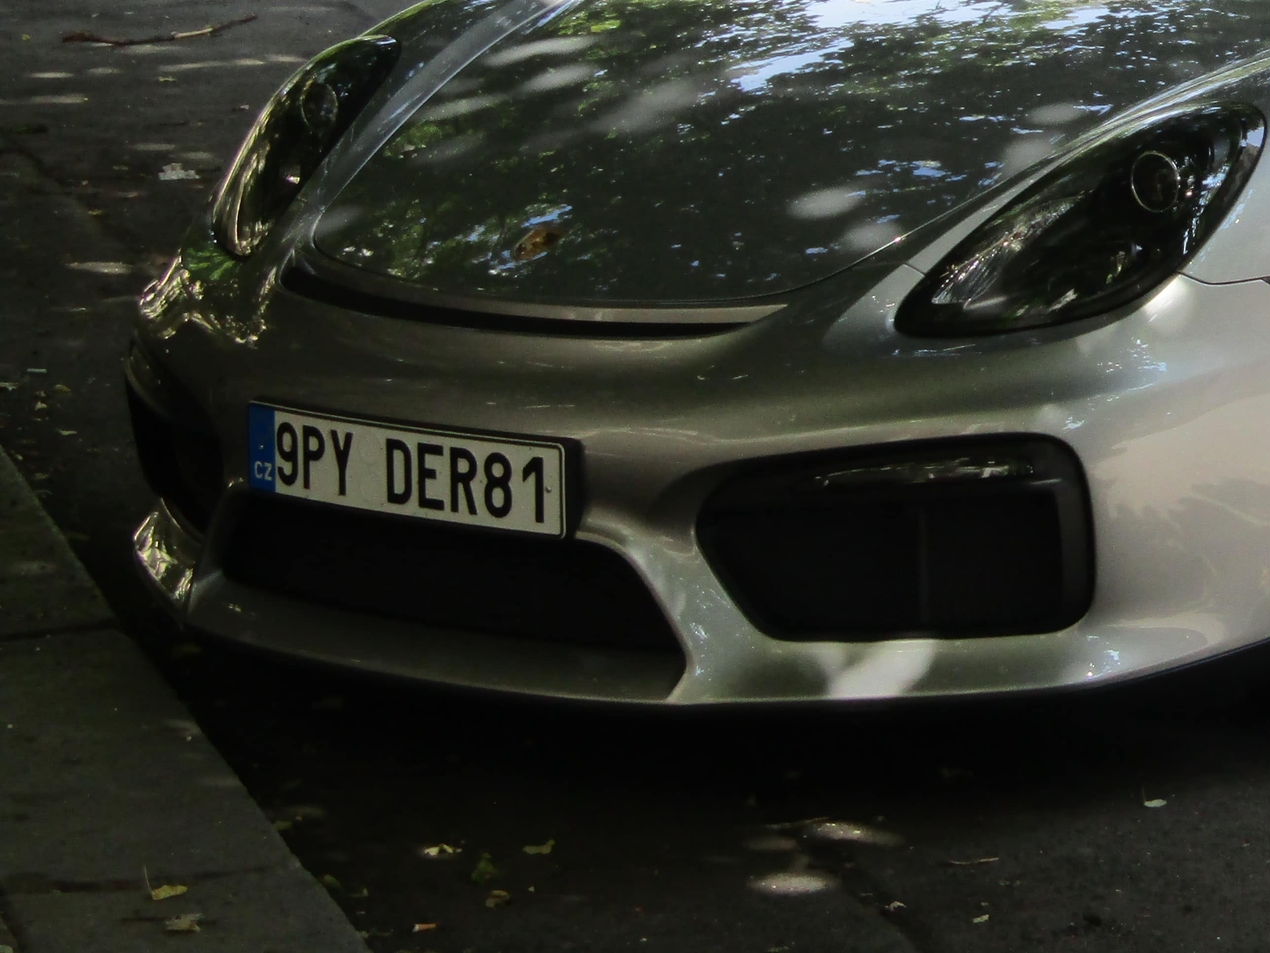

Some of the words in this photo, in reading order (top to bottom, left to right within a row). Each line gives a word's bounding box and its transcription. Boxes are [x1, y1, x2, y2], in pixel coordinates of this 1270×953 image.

[254, 460, 273, 481] CZ
[276, 421, 354, 497] 9PY
[386, 437, 545, 524] DER81
